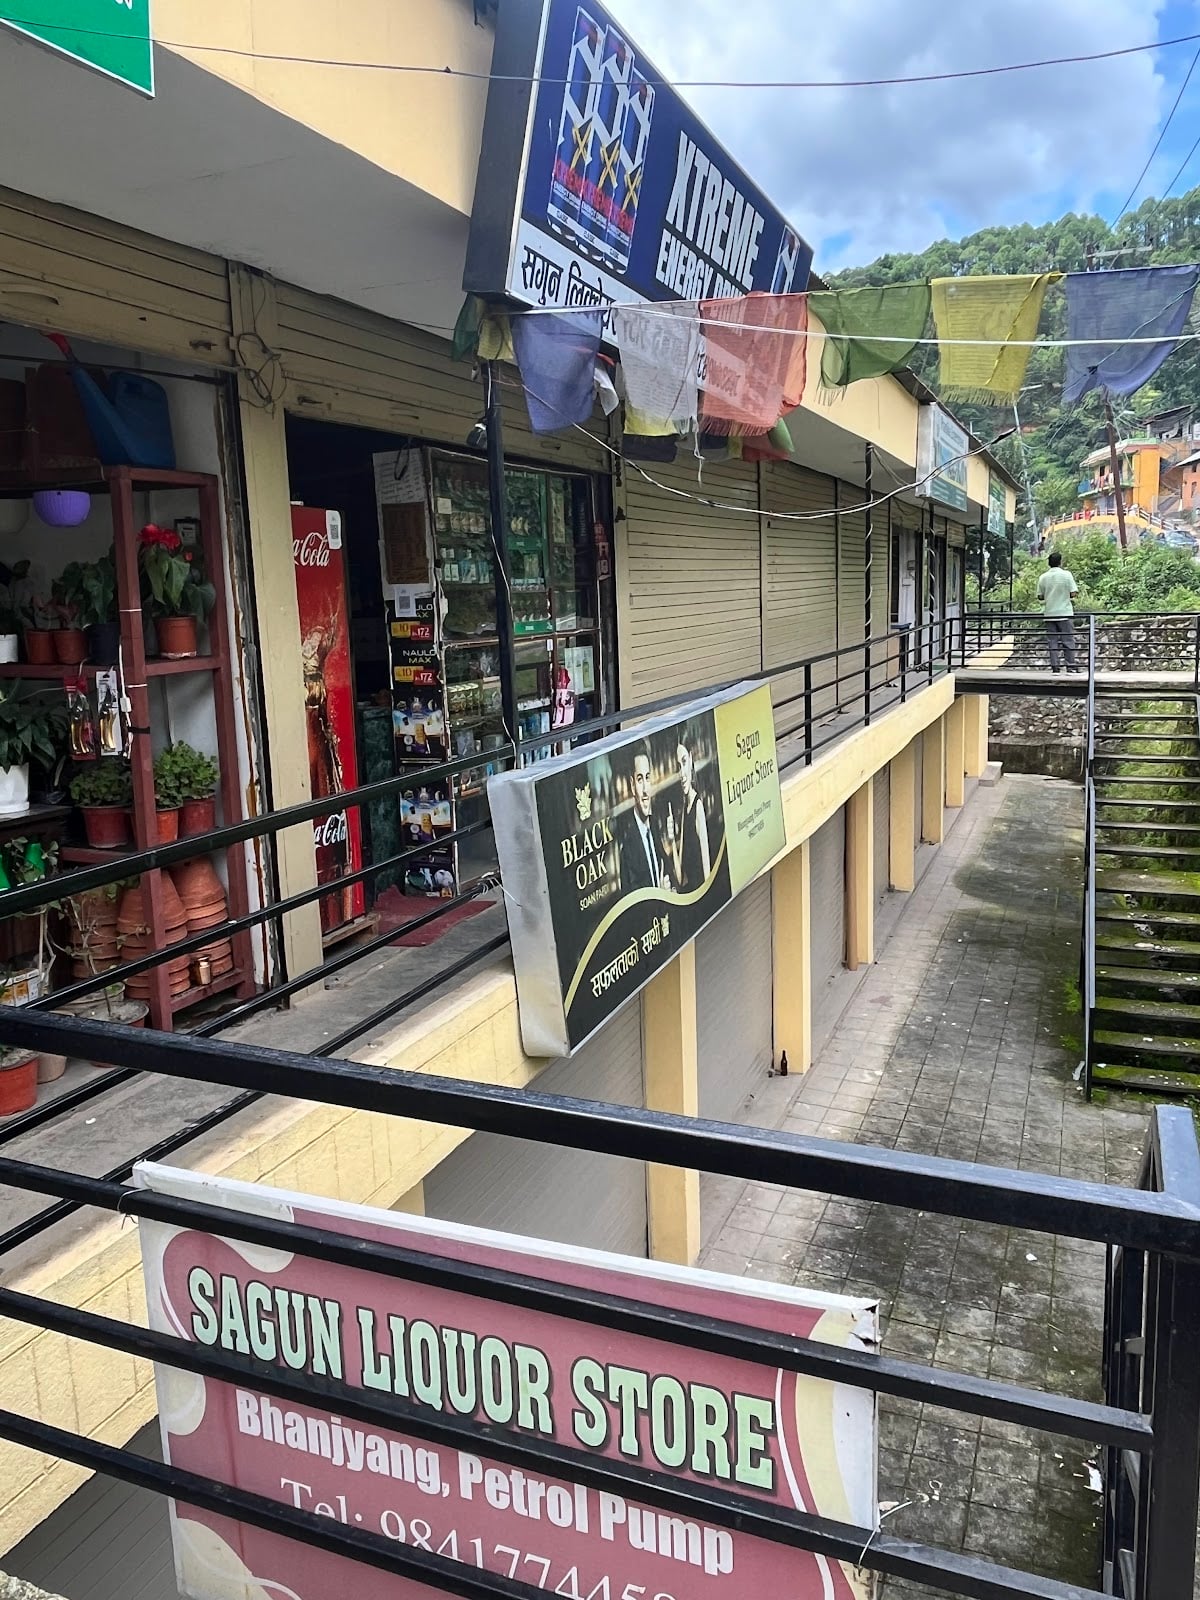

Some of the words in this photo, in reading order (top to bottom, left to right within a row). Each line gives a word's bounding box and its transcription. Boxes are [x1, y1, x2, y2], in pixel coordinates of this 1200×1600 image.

[665, 130, 765, 291] XTREME
[522, 245, 564, 305] सगुन
[655, 228, 714, 300] ENERGY
[402, 649, 437, 657] NAULO
[735, 729, 760, 760] Sagun
[726, 777, 754, 806] Liquor
[754, 758, 774, 785] Store
[561, 816, 614, 868] BLACK
[576, 851, 608, 890] OAK
[590, 937, 640, 997] सफलताको
[640, 916, 661, 954] साथी
[188, 1267, 344, 1380] SAGUN
[357, 1306, 553, 1435] LIQUOR
[571, 1356, 775, 1491] STORE
[235, 1389, 450, 1498] Bhanjyang,
[458, 1450, 589, 1534] Petrol
[599, 1491, 734, 1576] Pump
[380, 1509, 677, 1600] 98417744
